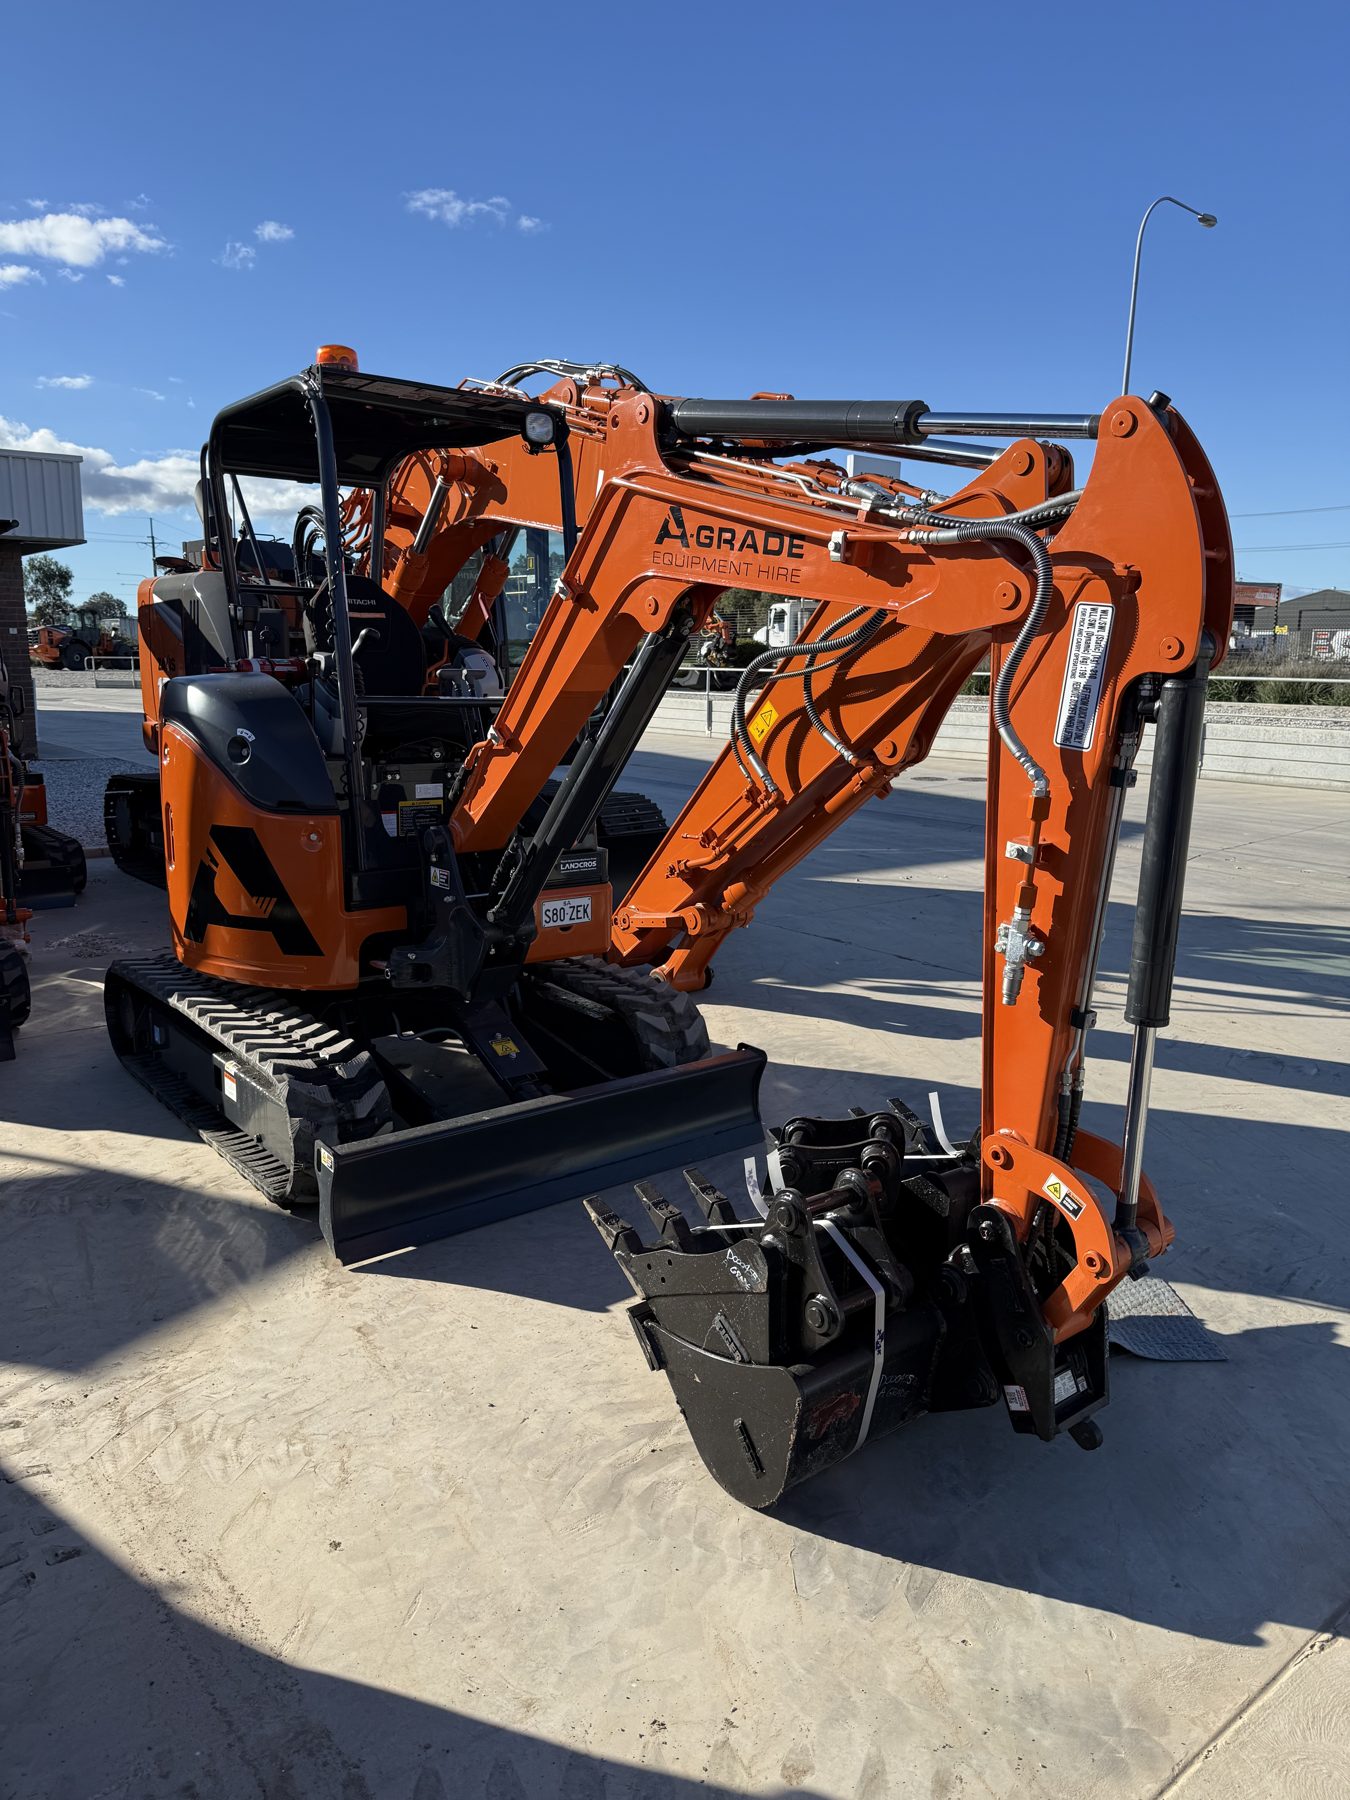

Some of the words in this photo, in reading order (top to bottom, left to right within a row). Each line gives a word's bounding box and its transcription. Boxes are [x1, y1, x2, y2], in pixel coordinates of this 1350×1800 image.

[652, 550, 753, 577] EQUIPMENT
[757, 564, 802, 584] HIRE
[560, 860, 597, 871] LANDCROS
